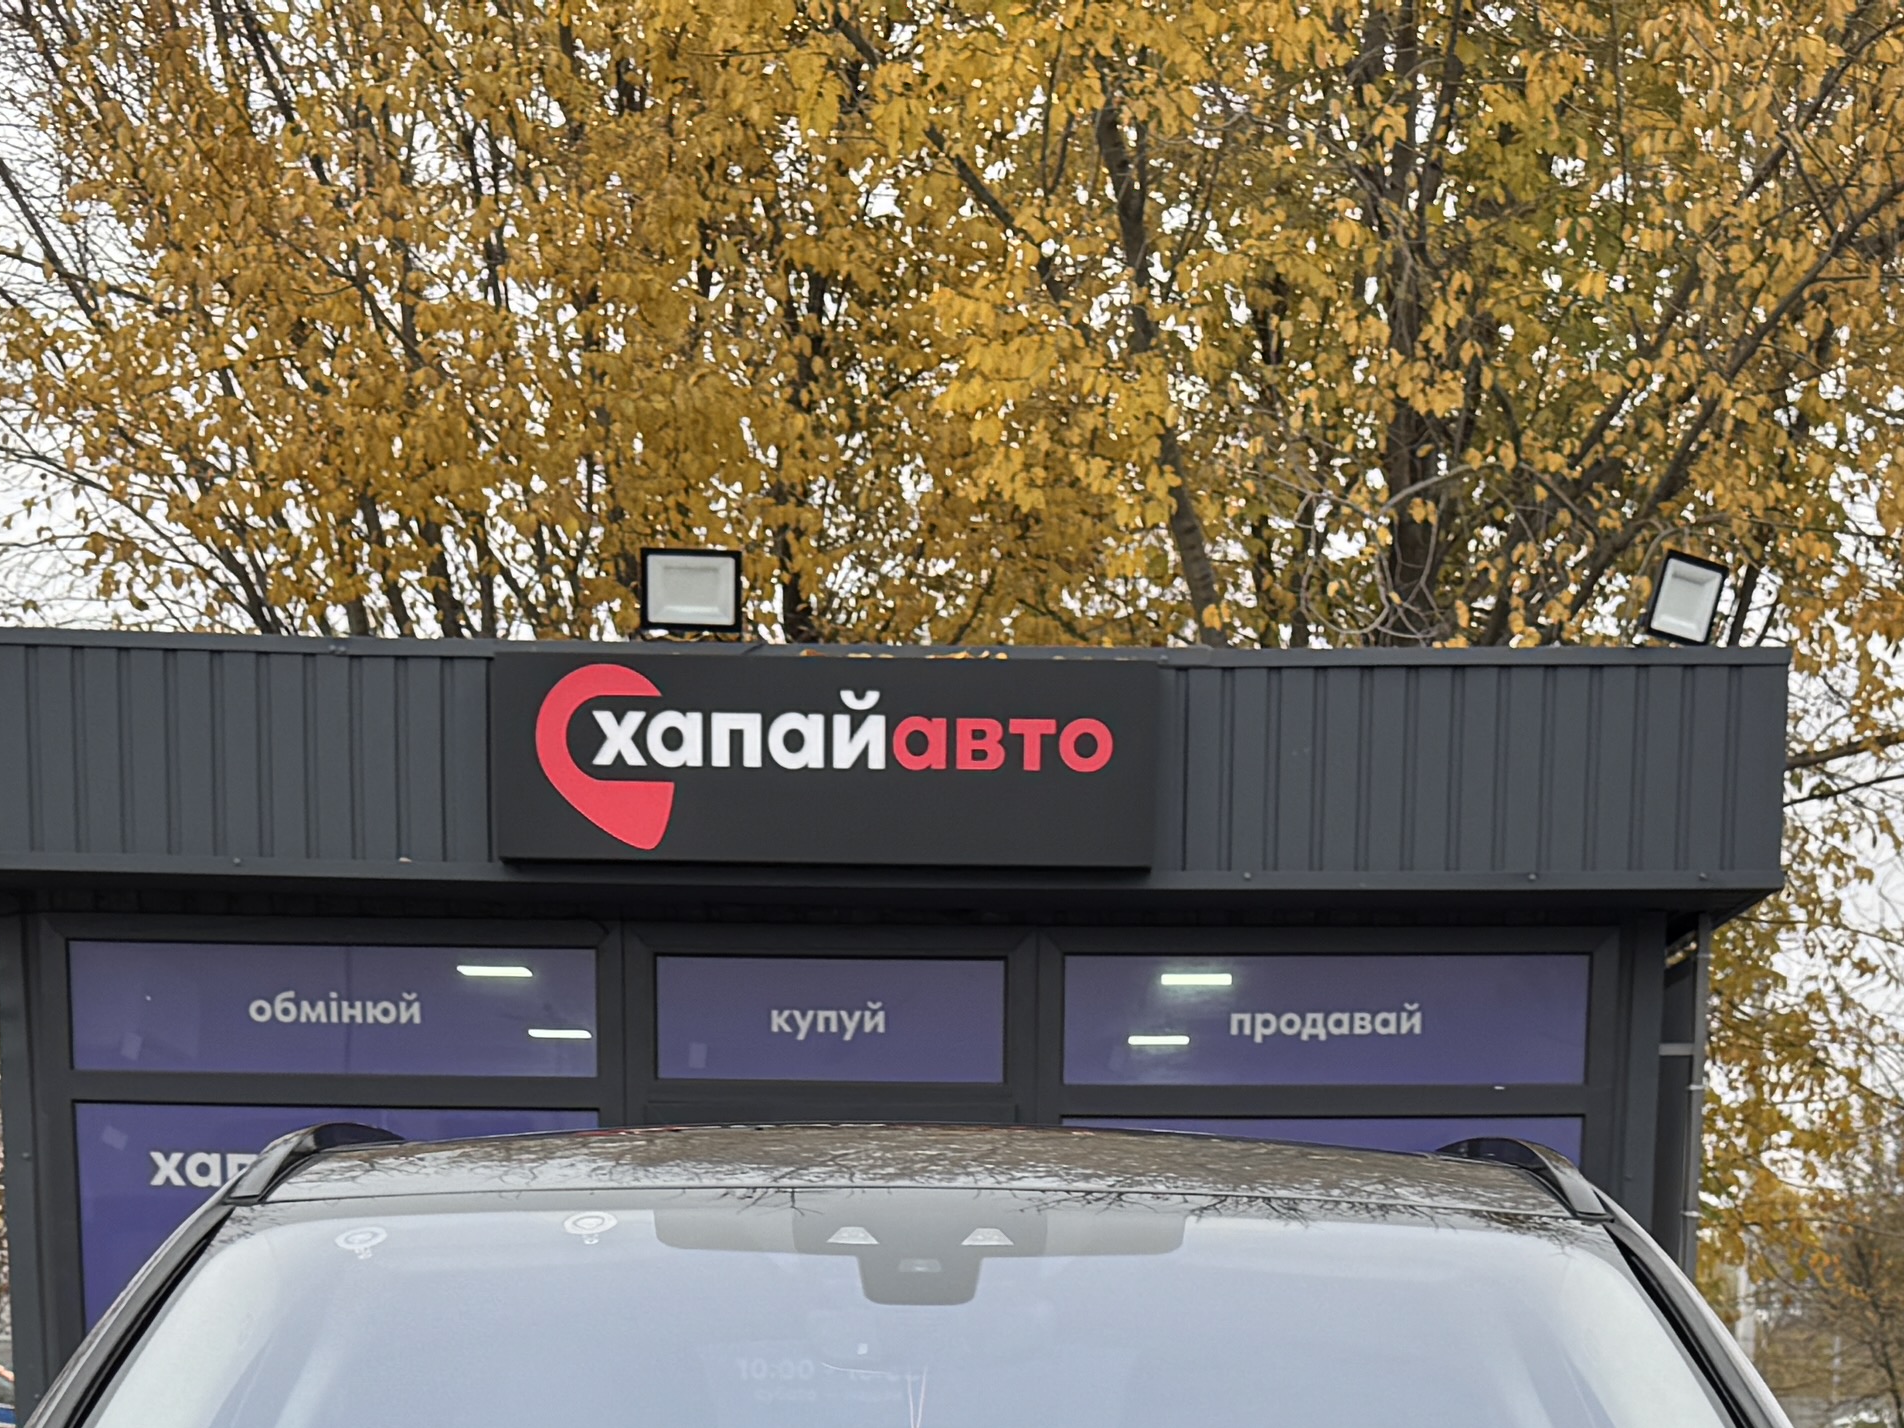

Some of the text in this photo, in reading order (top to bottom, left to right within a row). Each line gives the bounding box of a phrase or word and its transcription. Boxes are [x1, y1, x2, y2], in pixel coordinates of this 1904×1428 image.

[248, 990, 422, 1025] обмінюй
[770, 1001, 887, 1036] купуй
[1229, 1002, 1423, 1040] продавай
